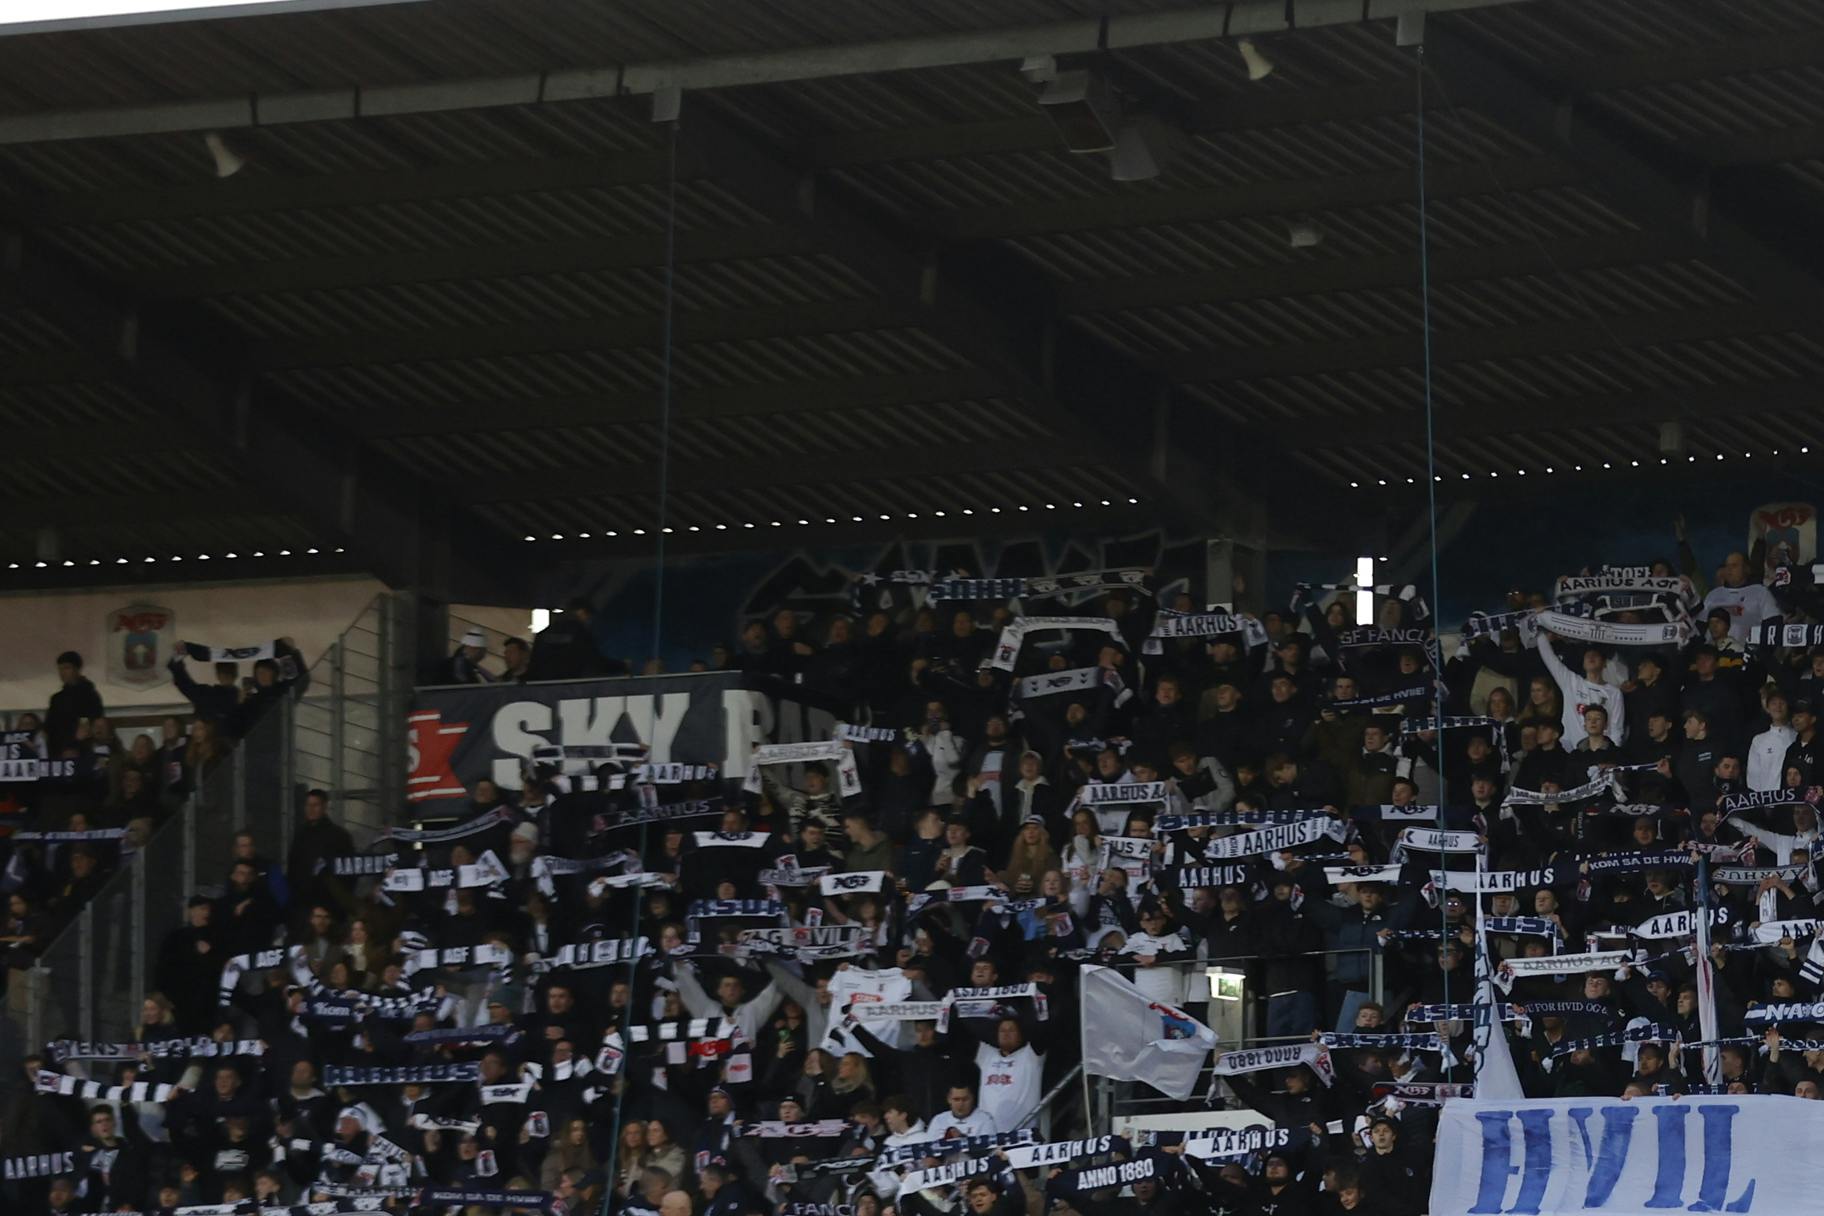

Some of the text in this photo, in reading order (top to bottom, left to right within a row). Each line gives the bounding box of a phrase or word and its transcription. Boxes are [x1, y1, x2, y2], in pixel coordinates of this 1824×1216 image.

[1175, 616, 1236, 635] AARHUS
[493, 692, 692, 792] SKY
[1091, 785, 1149, 800] AARHUS
[1726, 789, 1796, 810] AARHUS
[1244, 819, 1307, 854] AARHUS
[1427, 833, 1459, 848] AARHUS
[1590, 858, 1620, 870] KOM
[428, 870, 454, 886] AGF
[1178, 865, 1246, 887] AARHUS
[1475, 865, 1556, 886] AARHUS
[1651, 906, 1729, 935] AARHUS
[256, 949, 284, 967] AGF
[444, 947, 470, 963] AGF
[1032, 1135, 1111, 1163] AARHUS
[1211, 1129, 1290, 1155] AARHUS
[4, 1152, 74, 1179] AARHUS
[1472, 1102, 1756, 1214] HVIL
[922, 1157, 990, 1186] AARHUS
[1077, 1158, 1154, 1190] ANNO 1880
